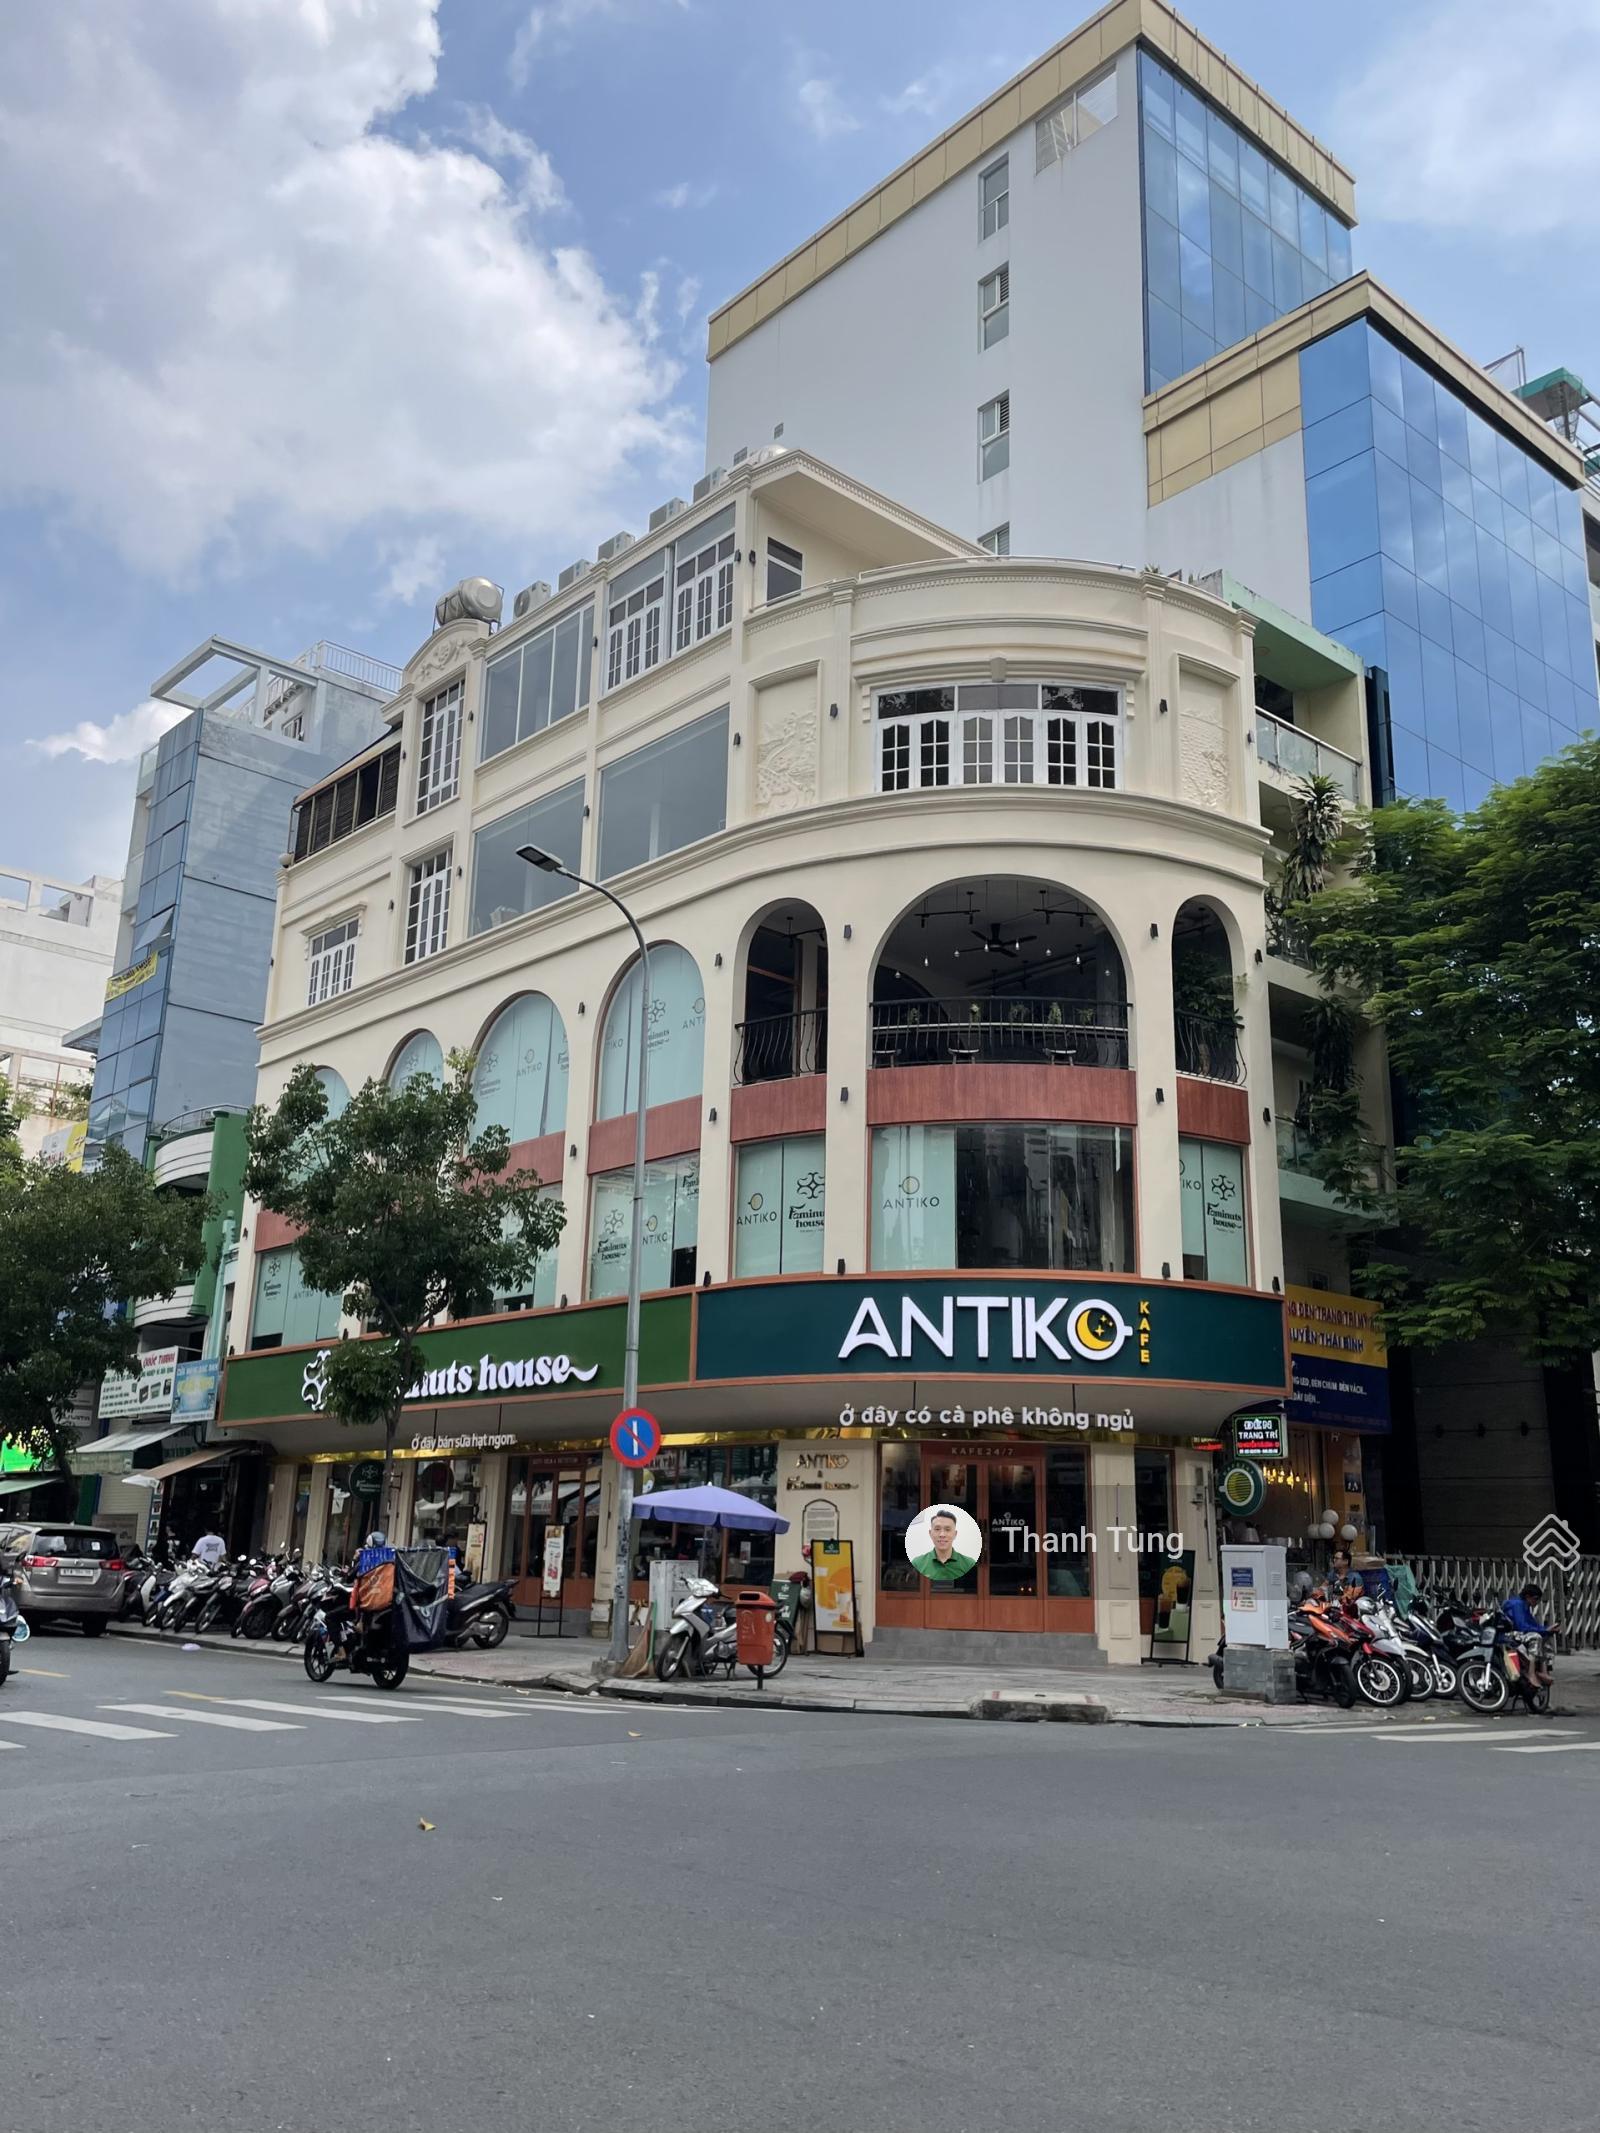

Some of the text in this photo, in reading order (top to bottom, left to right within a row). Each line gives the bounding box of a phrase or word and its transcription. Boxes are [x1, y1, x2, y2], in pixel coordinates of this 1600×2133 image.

[1182, 1179, 1202, 1190] IKO
[883, 1196, 940, 1210] ANTIKO
[736, 1211, 777, 1226] ANTIKO
[1207, 1202, 1242, 1221] Faminuts
[643, 1232, 668, 1245] NTIKO
[838, 1296, 1132, 1361] ANTIKO
[1139, 1300, 1151, 1363] KAFE
[404, 1354, 598, 1398] nuts house
[840, 1403, 1134, 1432] ở đây có cà phê không ngủ
[438, 1434, 453, 1449] bán
[472, 1433, 487, 1449] hạt
[1238, 1429, 1278, 1440] TRANG TRÍ
[796, 1454, 849, 1469] ANTIKO
[992, 1518, 1025, 1526] ANTIKO
